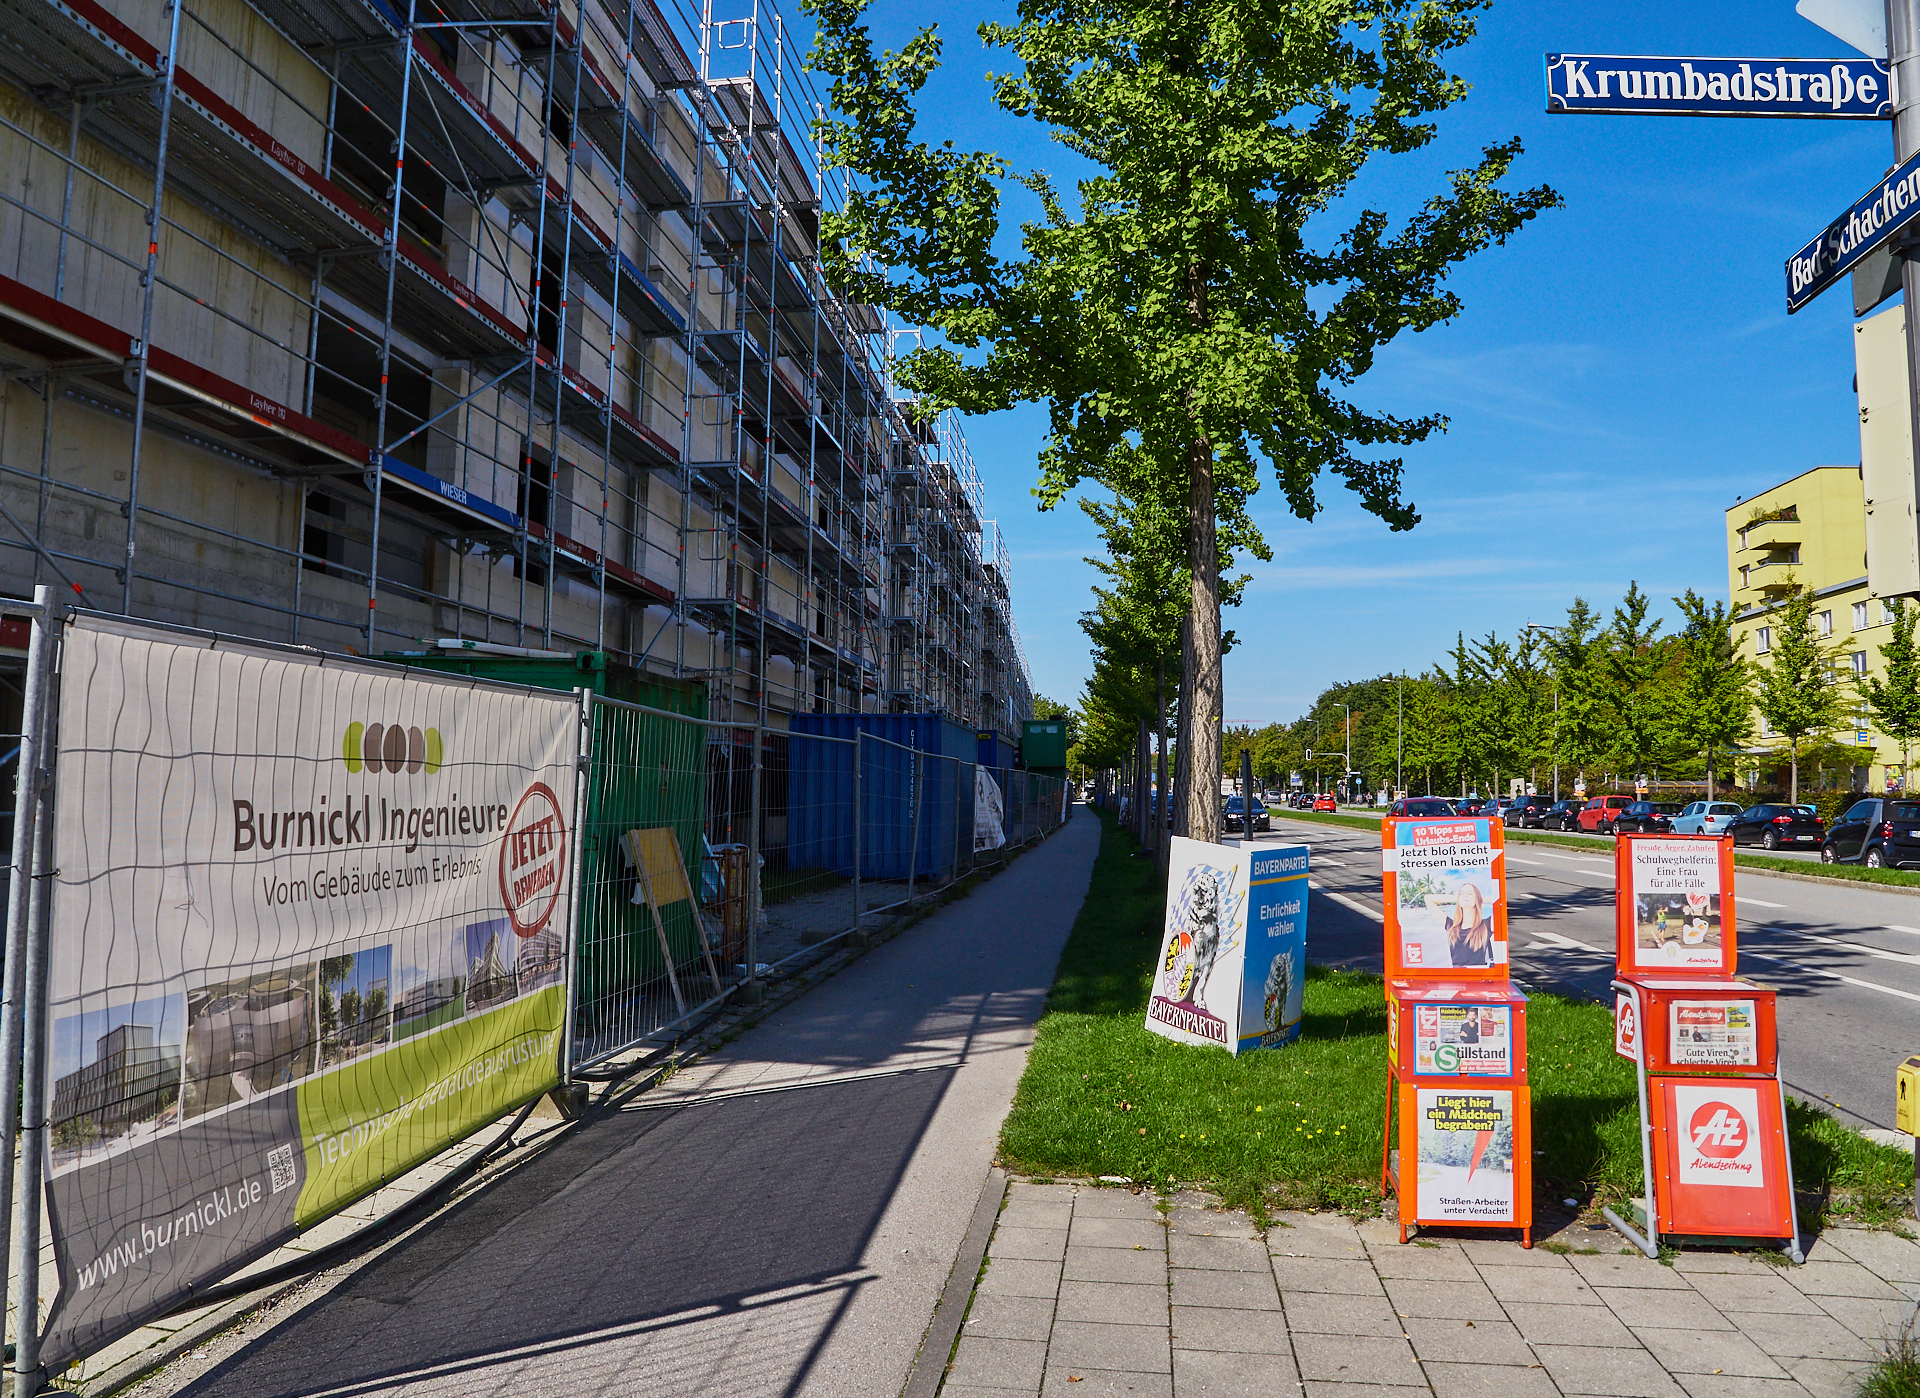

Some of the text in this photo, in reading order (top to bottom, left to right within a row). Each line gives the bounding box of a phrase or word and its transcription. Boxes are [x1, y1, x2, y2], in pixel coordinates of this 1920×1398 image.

[1563, 61, 1878, 110] Krumbadstraße
[250, 394, 276, 415] Layher
[440, 480, 467, 505] WIESER
[1857, 731, 1868, 742] E
[233, 793, 508, 853] Burnickl Ingenieure
[1415, 825, 1475, 836] 10 Tipps zum
[511, 814, 554, 871] JETZT
[1416, 832, 1476, 846] Urlaubs-Ende
[1400, 845, 1488, 858] Jetzt bloß nicht
[1687, 844, 1716, 852] Zahnfee
[1253, 856, 1307, 876] BAYERNPARTEI
[1400, 857, 1490, 868] stressen lassen!
[1636, 855, 1717, 866] Schulweghelferin:
[1656, 867, 1698, 876] Eine Frau
[263, 876, 307, 906] Vom
[313, 862, 391, 900] Gebäude
[395, 865, 429, 888] zum
[1650, 878, 1706, 888] für alle Fälle
[1260, 900, 1301, 920] Ehrlichkeit
[1267, 922, 1295, 938] wählen
[1406, 945, 1422, 963] tz
[1150, 998, 1226, 1043] BAYERNPARTEI
[1686, 1048, 1706, 1057] Gute
[1438, 1097, 1492, 1110] Liegt hier
[1428, 1109, 1501, 1120] ein Mädchen
[313, 1095, 418, 1168] Technische
[1435, 1119, 1494, 1132] begraben?
[1690, 1158, 1752, 1174] Abendzeitung
[1439, 1197, 1509, 1206] Straßen-Arbeiter
[1468, 1207, 1508, 1215] Verdacht!
[77, 1178, 262, 1291] www.burnickl.de
